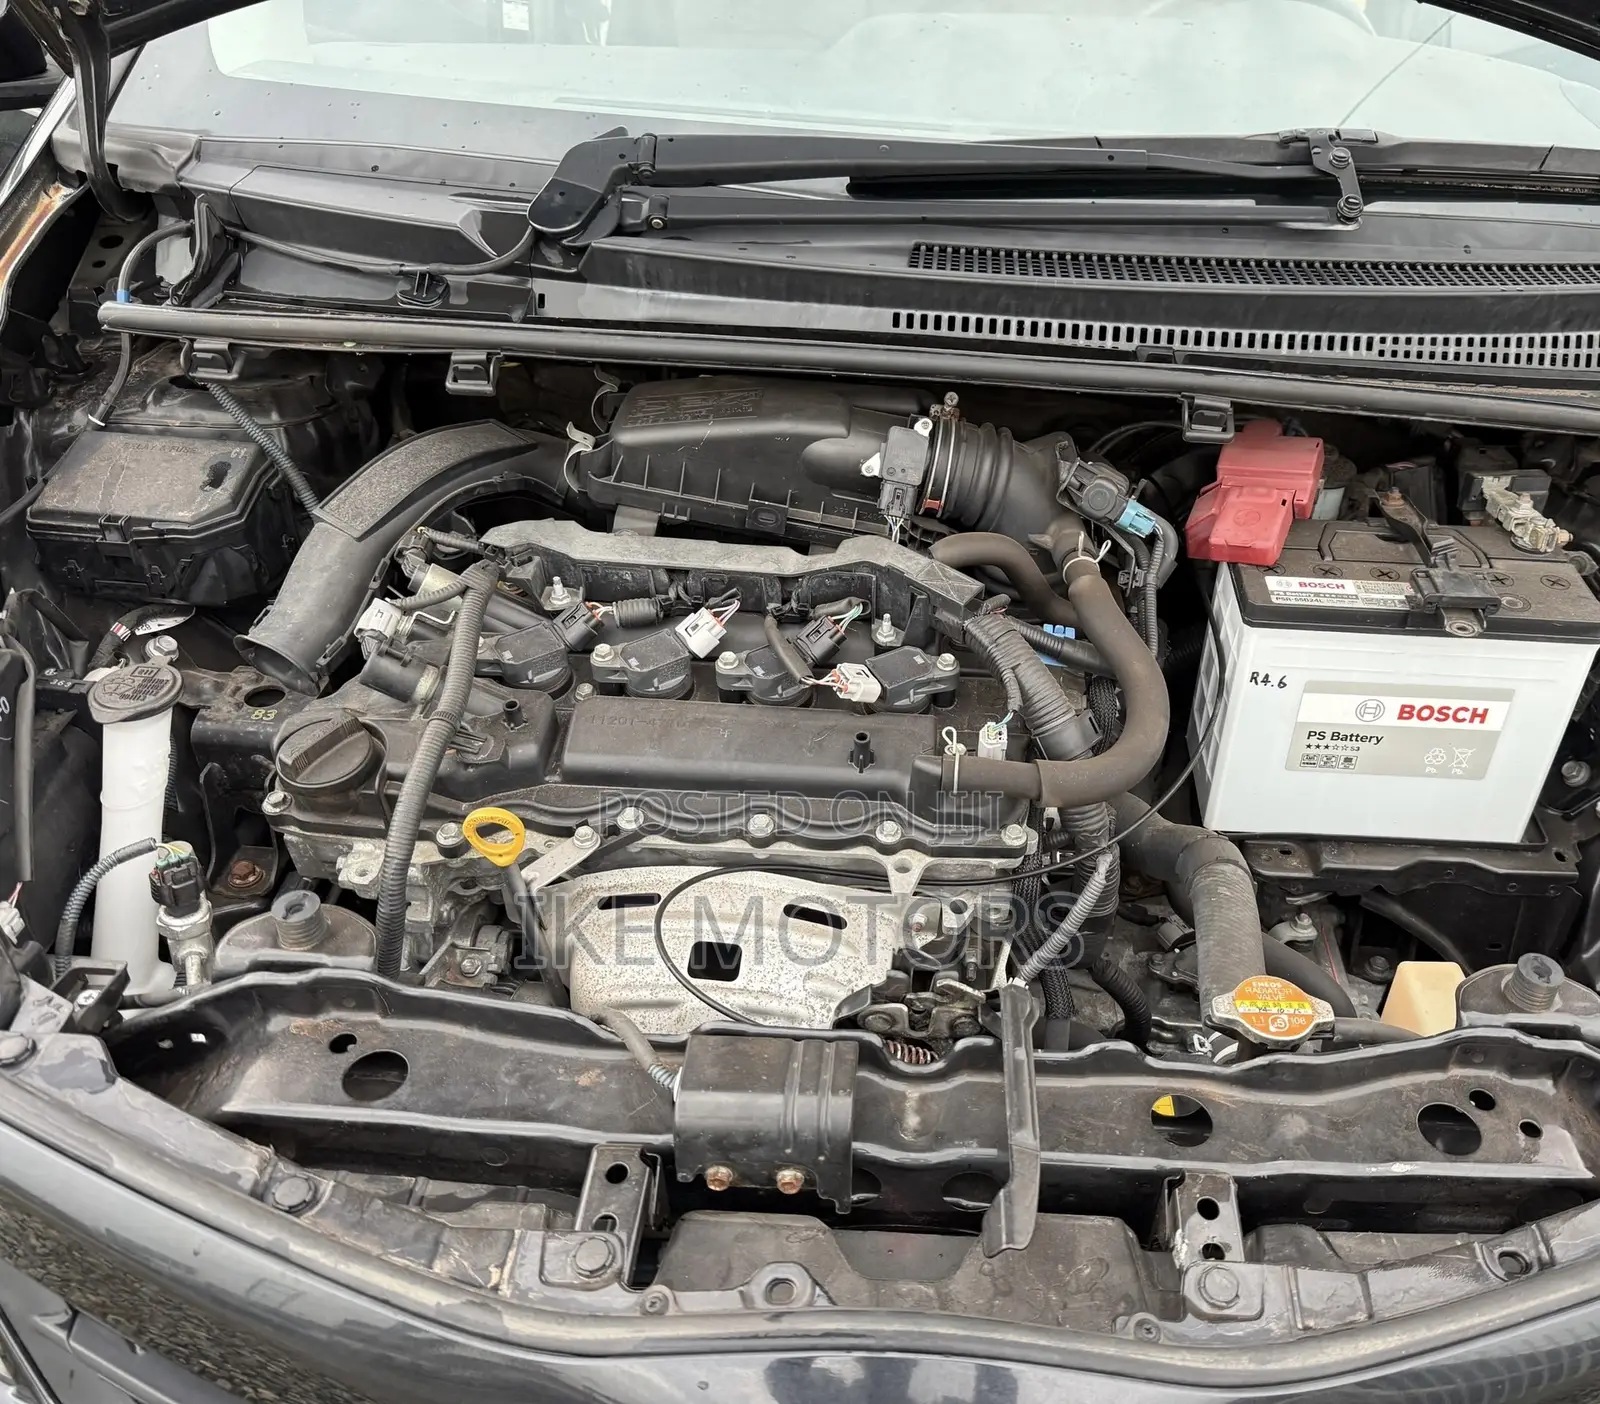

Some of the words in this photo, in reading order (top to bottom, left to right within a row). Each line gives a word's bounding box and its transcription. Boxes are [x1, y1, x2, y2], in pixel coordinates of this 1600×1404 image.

[1298, 581, 1346, 590] BOSCH
[1249, 671, 1287, 689] R4.6
[1397, 704, 1489, 724] BOSCH
[1306, 730, 1327, 741] PS
[1330, 731, 1384, 746] Battery
